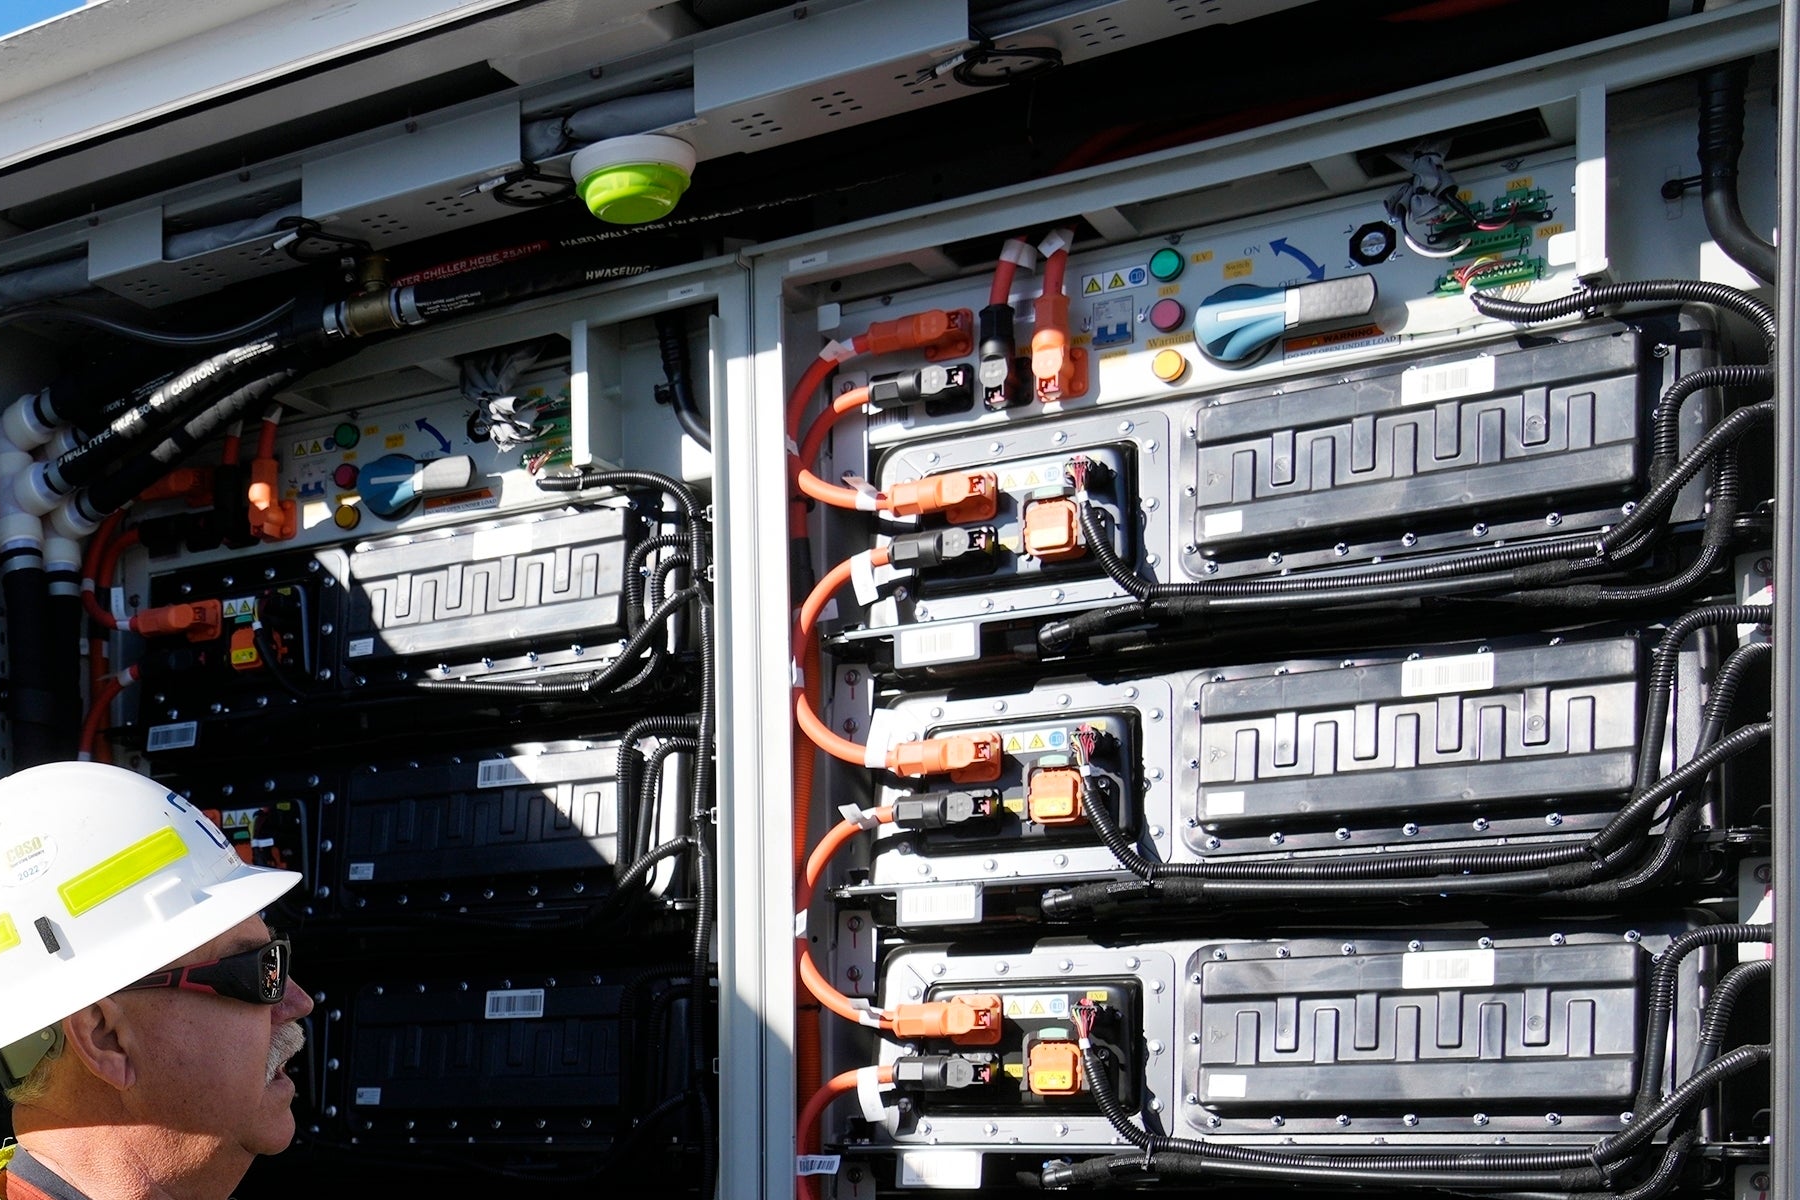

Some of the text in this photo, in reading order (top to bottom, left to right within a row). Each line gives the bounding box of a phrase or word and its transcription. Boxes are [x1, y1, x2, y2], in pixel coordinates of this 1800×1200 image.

[1196, 252, 1208, 263] LV
[1243, 245, 1261, 257] ON
[423, 261, 467, 283] CHILLER
[468, 255, 499, 269] HOSE
[1225, 261, 1251, 273] Switch
[1148, 332, 1192, 348] Warning
[1323, 328, 1374, 343] WARNING
[1287, 336, 1397, 359] DO NOT OPEN UNDER LOAD
[171, 363, 220, 395] CAUTION:
[64, 443, 88, 462] WALL
[18, 865, 40, 881] 2022
